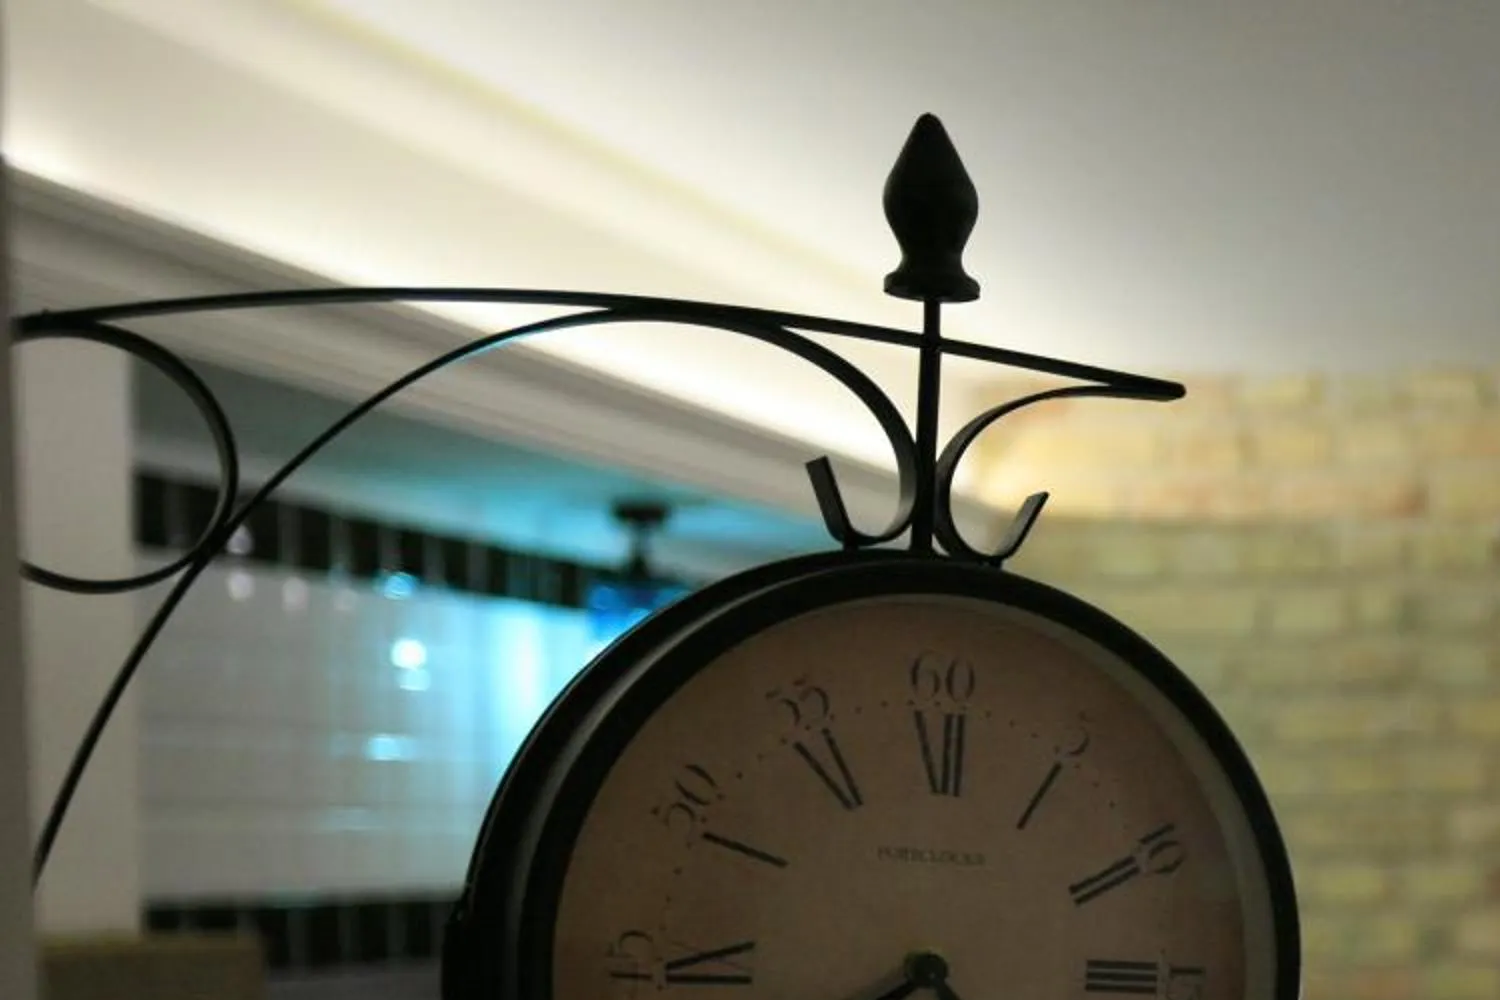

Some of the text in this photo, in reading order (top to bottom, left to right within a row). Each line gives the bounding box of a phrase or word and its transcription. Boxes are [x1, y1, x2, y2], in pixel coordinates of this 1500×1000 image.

[910, 650, 976, 702] 60
[651, 764, 718, 840] 50
[1016, 761, 1063, 830] I
[1137, 823, 1187, 875] 10
[1068, 855, 1141, 905] II
[1085, 959, 1159, 994] III
